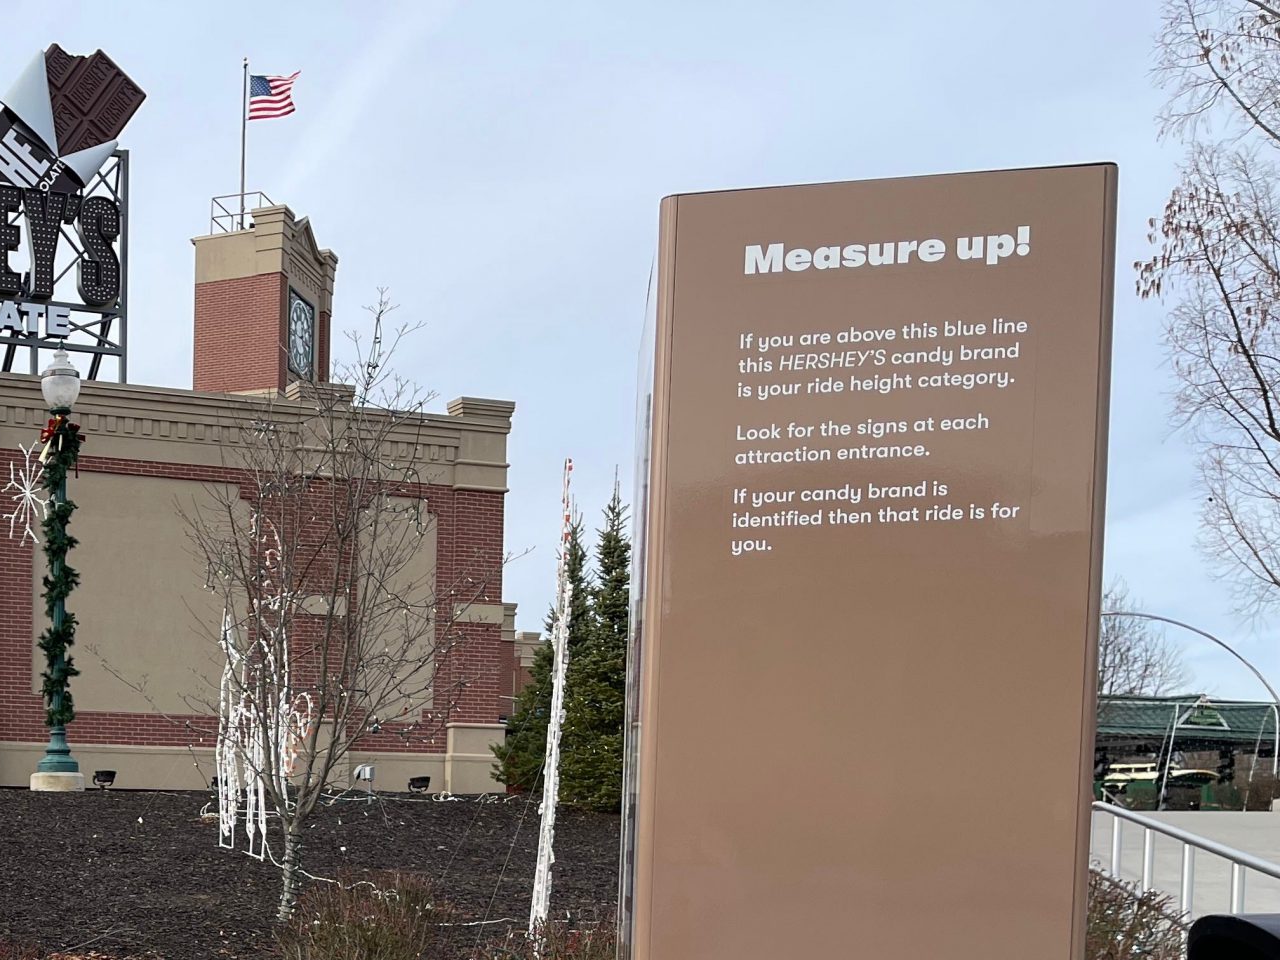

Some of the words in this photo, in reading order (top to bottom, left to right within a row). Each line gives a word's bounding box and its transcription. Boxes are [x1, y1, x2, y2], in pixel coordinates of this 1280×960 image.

[71, 56, 115, 108] HERSHEY'S
[97, 77, 138, 132] HERSHEY'S
[744, 237, 946, 275] Measure
[956, 225, 1030, 265] up!
[739, 333, 753, 350] If
[758, 334, 793, 352] you
[799, 330, 831, 346] are
[836, 326, 896, 343] above
[901, 323, 938, 340] this
[944, 320, 986, 338] blue
[993, 318, 1028, 335] line
[738, 356, 773, 373] this
[779, 349, 887, 371] HERSHEY'S
[891, 346, 954, 366] candy
[960, 342, 1020, 361] brand
[737, 382, 752, 398] is
[758, 383, 801, 400] your
[807, 378, 844, 395] ride
[849, 373, 912, 394] height
[917, 370, 1015, 389] category.
[736, 423, 781, 441] Look
[787, 422, 814, 439] for
[820, 420, 852, 437] the
[856, 418, 908, 438] signs
[913, 417, 934, 432] at
[940, 413, 989, 431] each
[734, 446, 831, 465] attraction
[836, 443, 930, 460] entrance.
[733, 488, 747, 504] If
[752, 489, 796, 508] your
[800, 484, 862, 504] candy
[868, 481, 926, 499] brand
[932, 480, 948, 497] is
[732, 509, 822, 528] identified
[828, 508, 871, 525] then
[877, 506, 919, 523] that
[924, 504, 963, 521] ride
[969, 504, 985, 520] is
[991, 502, 1020, 519] for
[731, 539, 772, 555] you.
